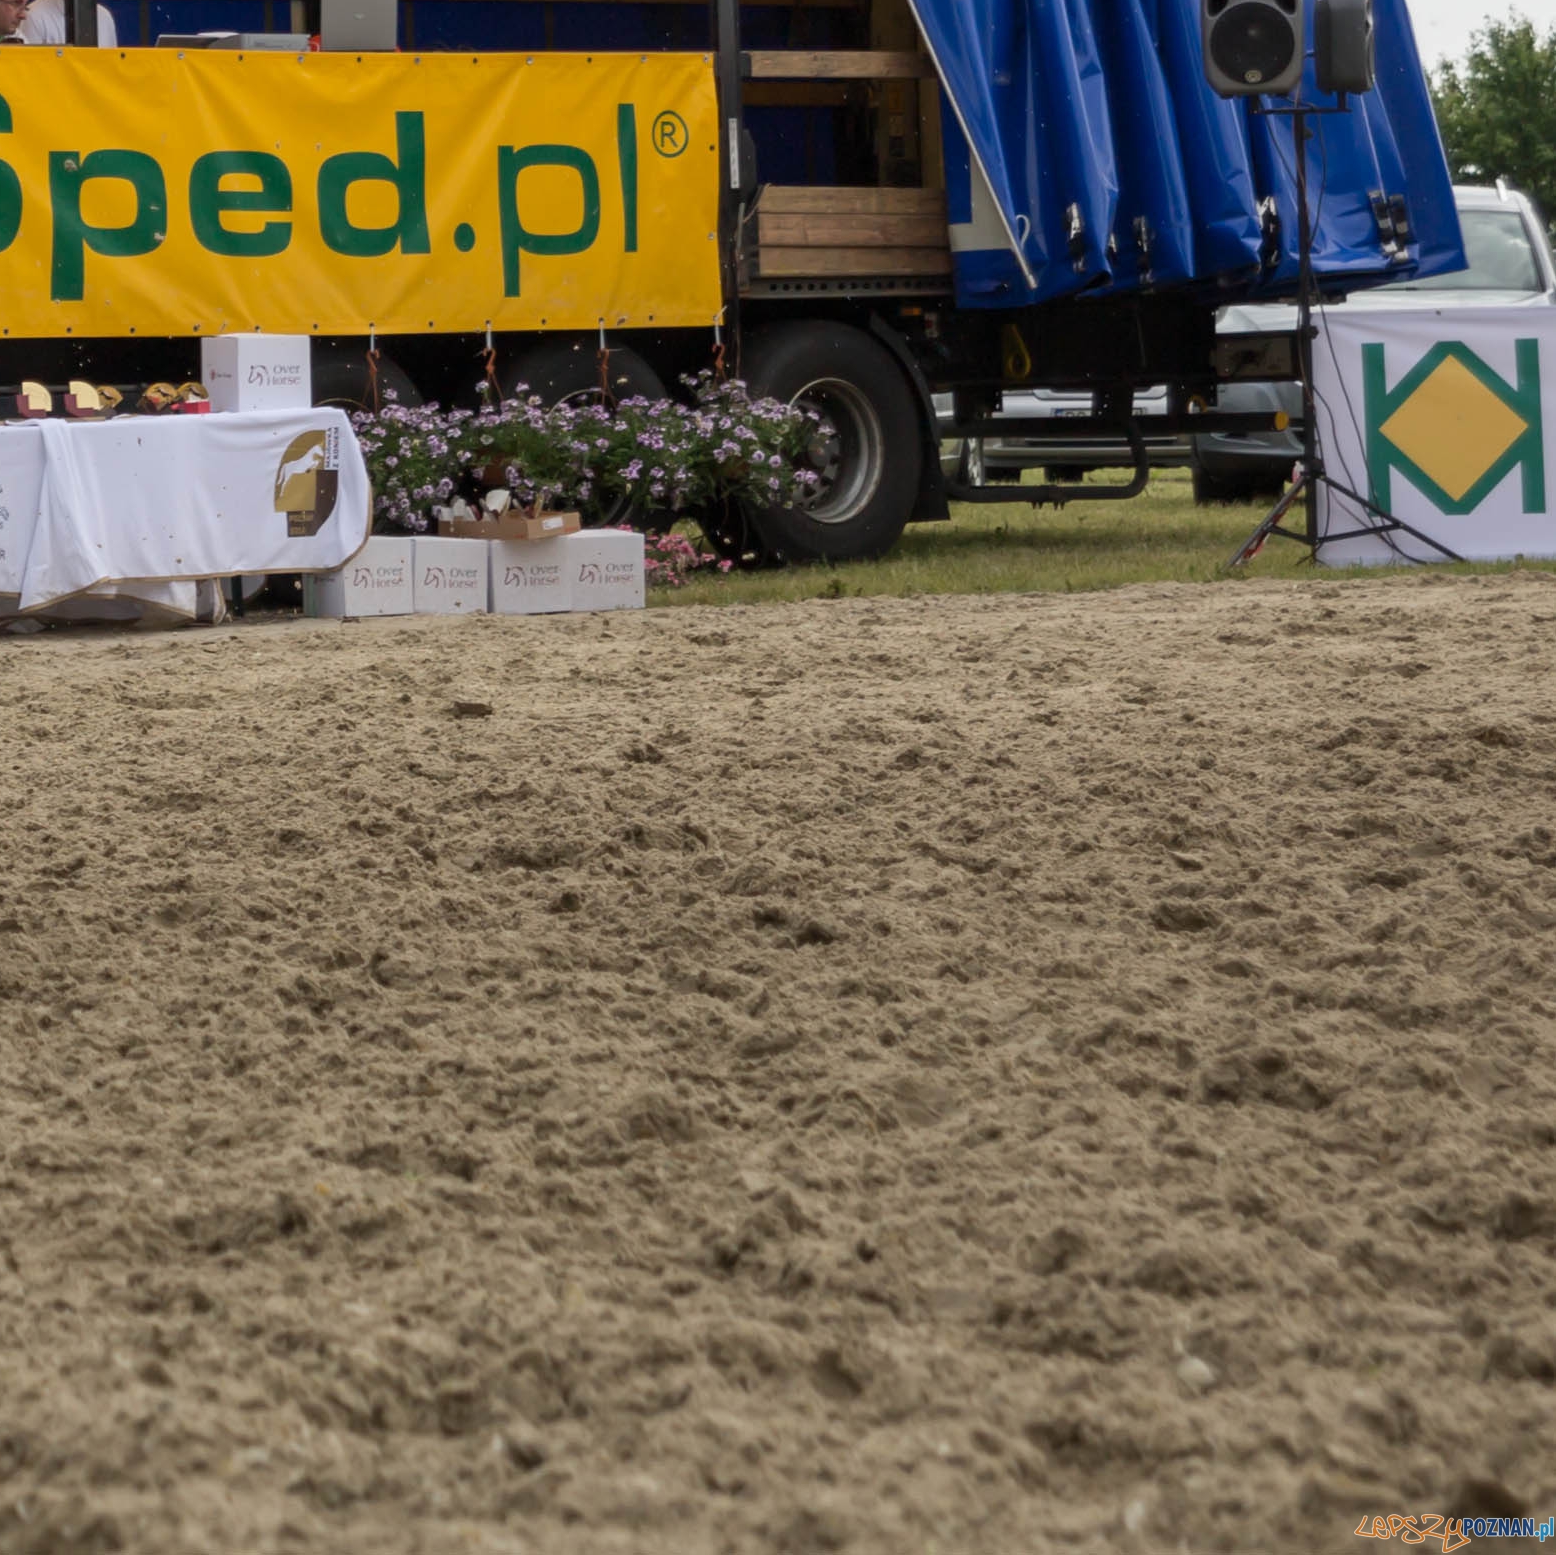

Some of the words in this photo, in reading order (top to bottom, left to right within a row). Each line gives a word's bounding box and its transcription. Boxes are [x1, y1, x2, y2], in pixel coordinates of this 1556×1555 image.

[273, 364, 301, 375] Over
[376, 566, 404, 577] Over
[450, 567, 478, 578] Over
[530, 564, 560, 575] Over
[605, 562, 634, 572] Over
